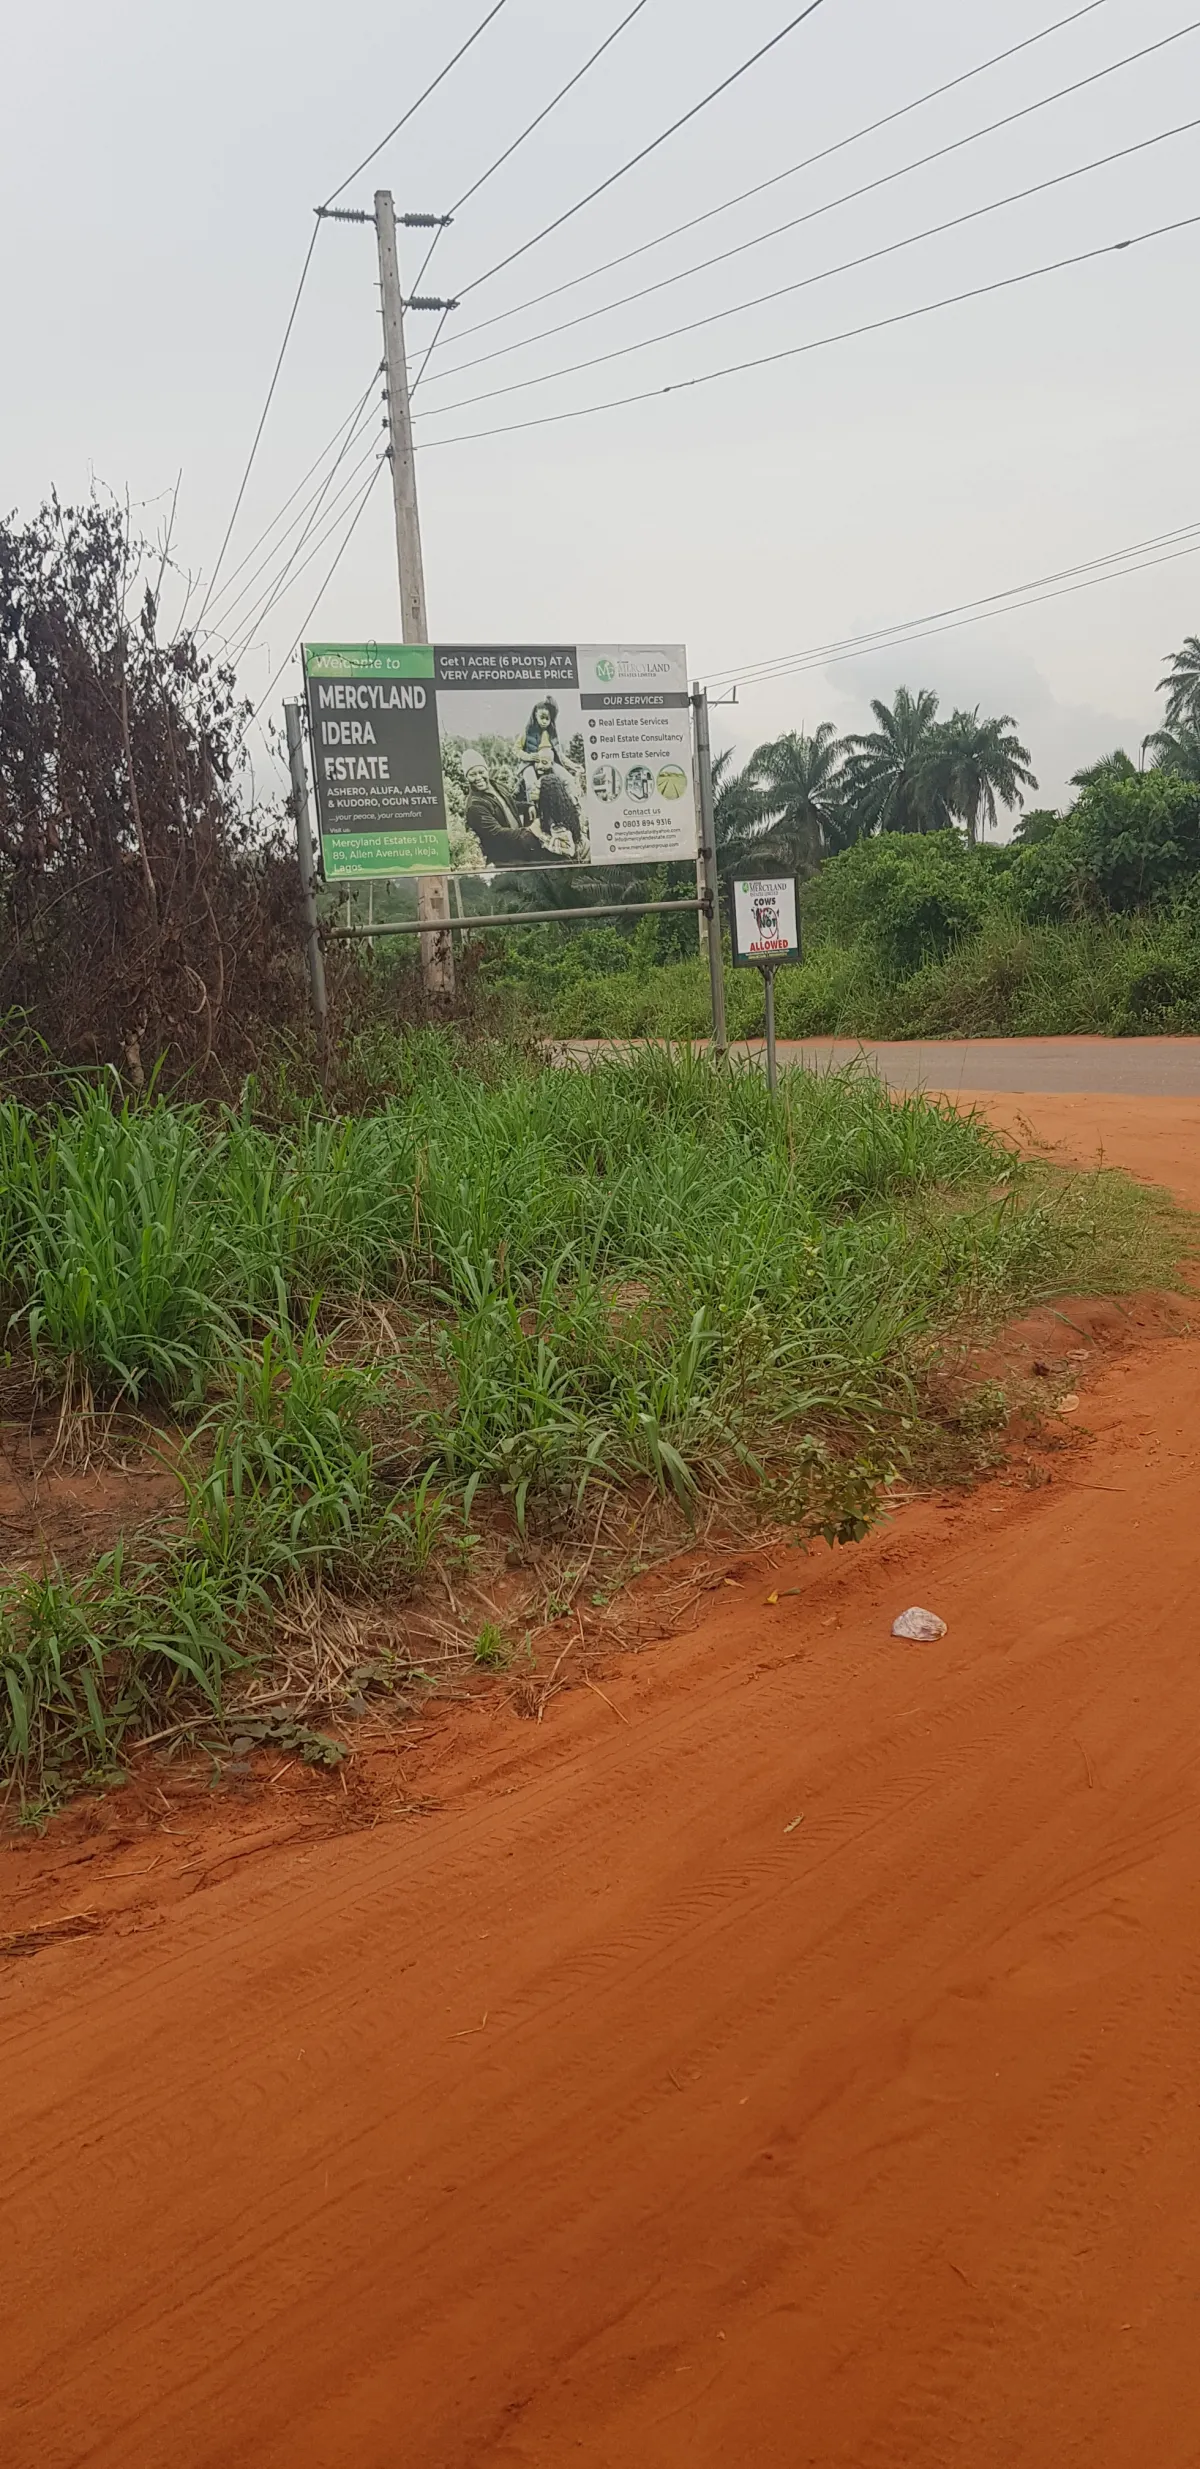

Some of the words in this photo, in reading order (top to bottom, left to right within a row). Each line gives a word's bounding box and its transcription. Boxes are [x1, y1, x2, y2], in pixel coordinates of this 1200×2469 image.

[316, 656, 382, 669] Welcome
[386, 656, 401, 669] to
[440, 656, 459, 666] Get
[461, 656, 466, 666] 1
[468, 656, 497, 666] ACRE
[499, 655, 510, 668] (6
[511, 655, 547, 668] PLOTS)
[549, 656, 563, 666] AT
[564, 656, 573, 666] A
[618, 663, 671, 673] MERCYLAND
[440, 670, 468, 680] VERY
[471, 669, 542, 680] AFFORDABLE
[544, 669, 574, 679] PRICE
[318, 684, 427, 709] MERCYLAND
[603, 696, 623, 705] OUR
[624, 695, 664, 705] SERVICES
[598, 718, 615, 727] Real
[616, 718, 639, 727] Estate
[640, 717, 669, 726] Services
[321, 721, 377, 745] IDERA
[600, 735, 616, 743] Real
[617, 734, 640, 742] Estate
[641, 733, 684, 743] Consultancy
[601, 751, 620, 760] Farm
[621, 751, 643, 759] Estate
[645, 749, 670, 758] Service
[324, 756, 390, 780] ESTATE
[327, 787, 369, 797] ASHERO,
[370, 785, 403, 796] ALUFA,
[404, 785, 432, 795] AARE,
[328, 799, 335, 808] &
[337, 798, 381, 808] KUDORO,
[382, 797, 410, 806] OGUN
[411, 796, 439, 805] STATE
[352, 811, 377, 821] peace,
[378, 811, 393, 820] your
[394, 810, 422, 819] comfort
[623, 808, 651, 816] Contact
[622, 820, 641, 828] 0803
[641, 819, 655, 827] 894
[656, 818, 672, 826] 9316
[332, 836, 381, 849] Mercyland
[383, 836, 417, 846] Estates
[419, 834, 439, 844] LTD,
[332, 851, 347, 861] 89,
[349, 849, 374, 860] Allen
[376, 849, 413, 857] Avenue,
[414, 847, 439, 857] Ikeja,
[749, 883, 787, 892] MERCYLAND
[753, 897, 776, 907] COWS
[760, 918, 777, 928] NOT
[750, 939, 789, 952] ALLOWED
